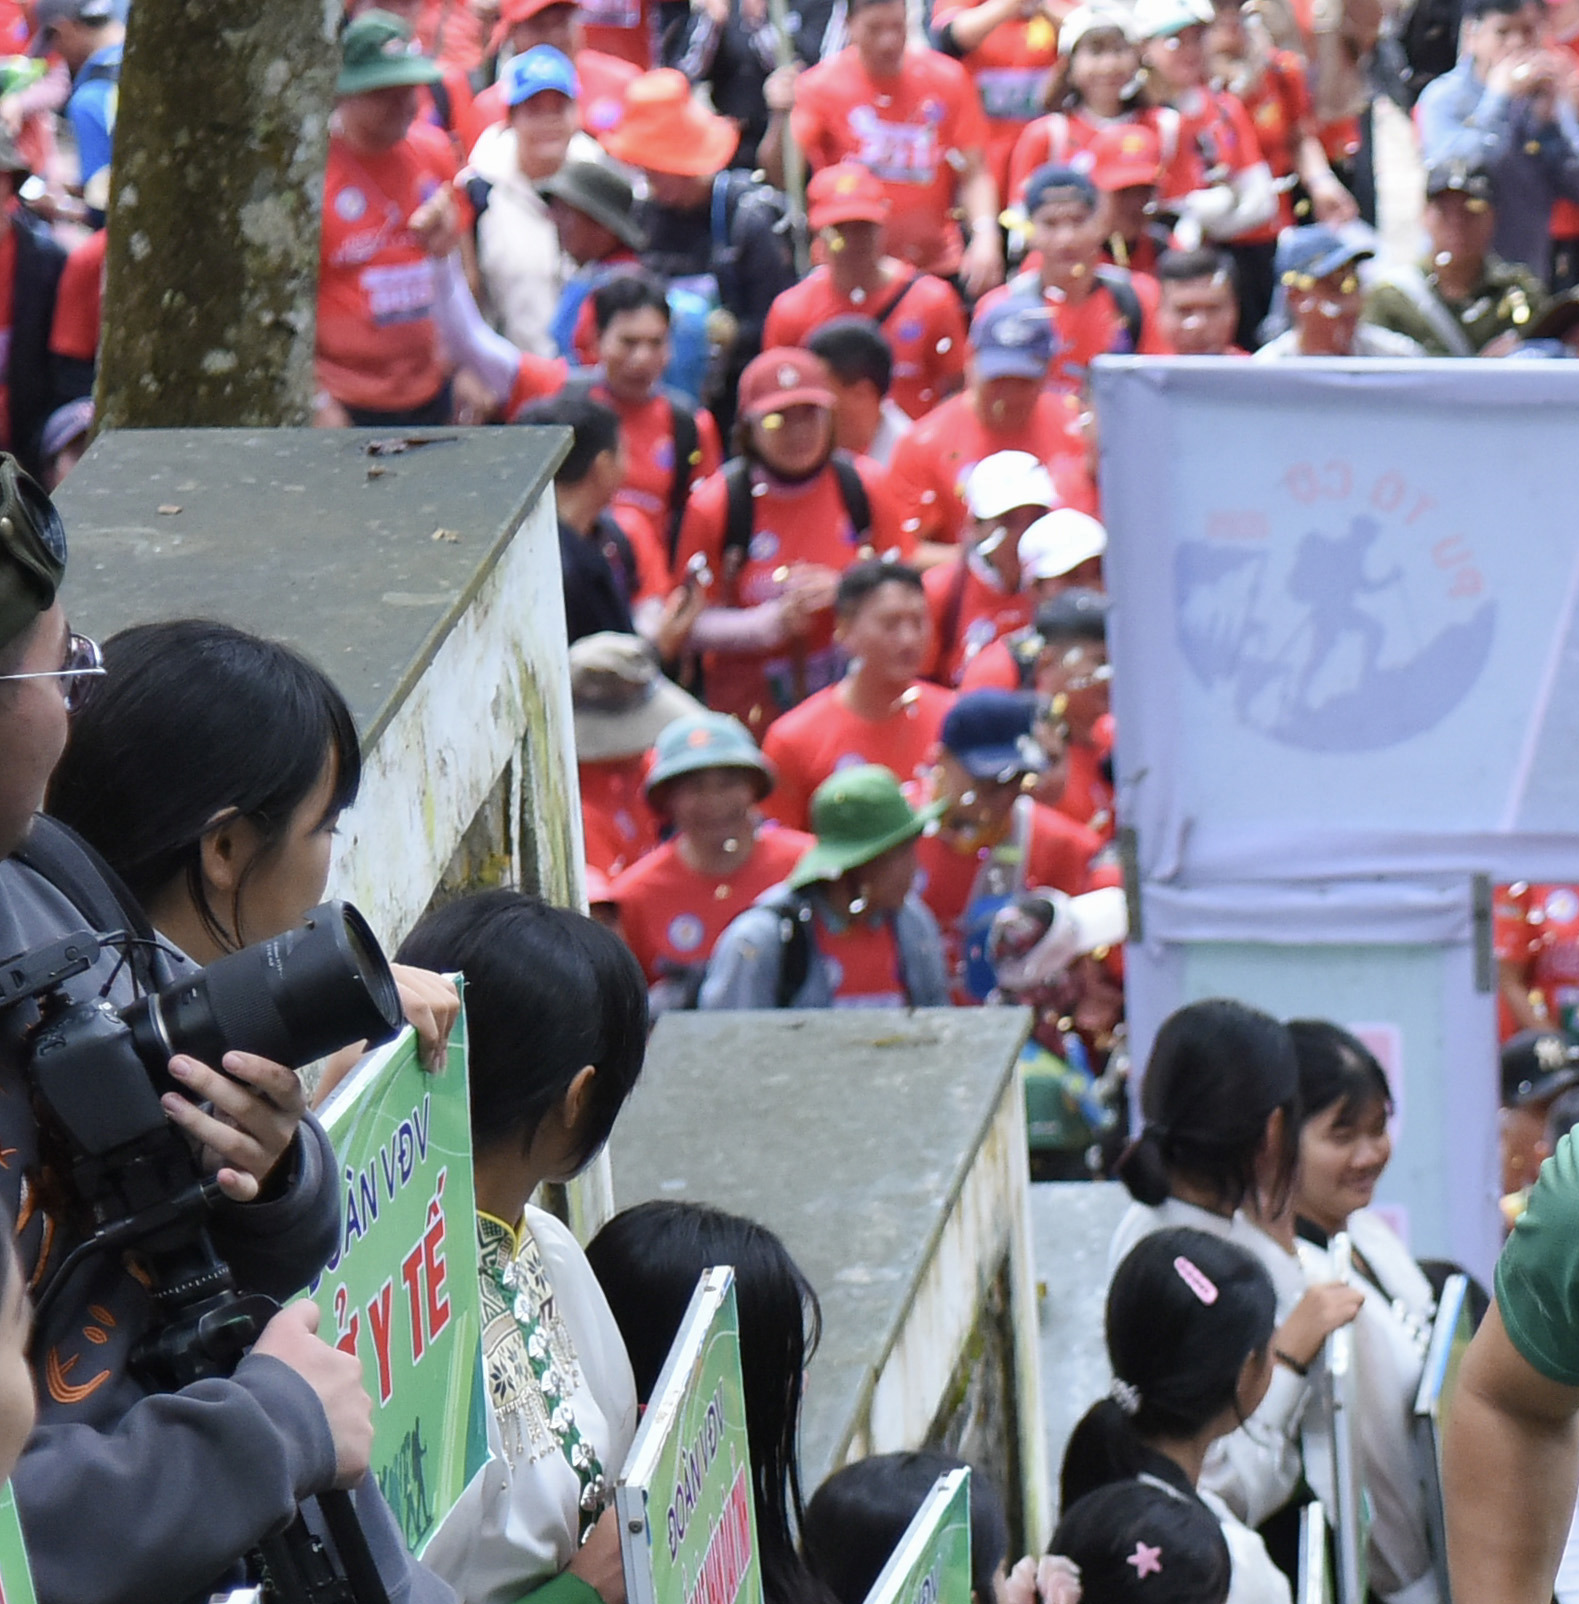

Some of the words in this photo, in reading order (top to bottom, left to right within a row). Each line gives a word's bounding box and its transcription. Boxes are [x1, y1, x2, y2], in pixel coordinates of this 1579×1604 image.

[379, 1091, 431, 1203] VĐV
[366, 1275, 393, 1409] Y
[401, 1164, 452, 1346] TẾ
